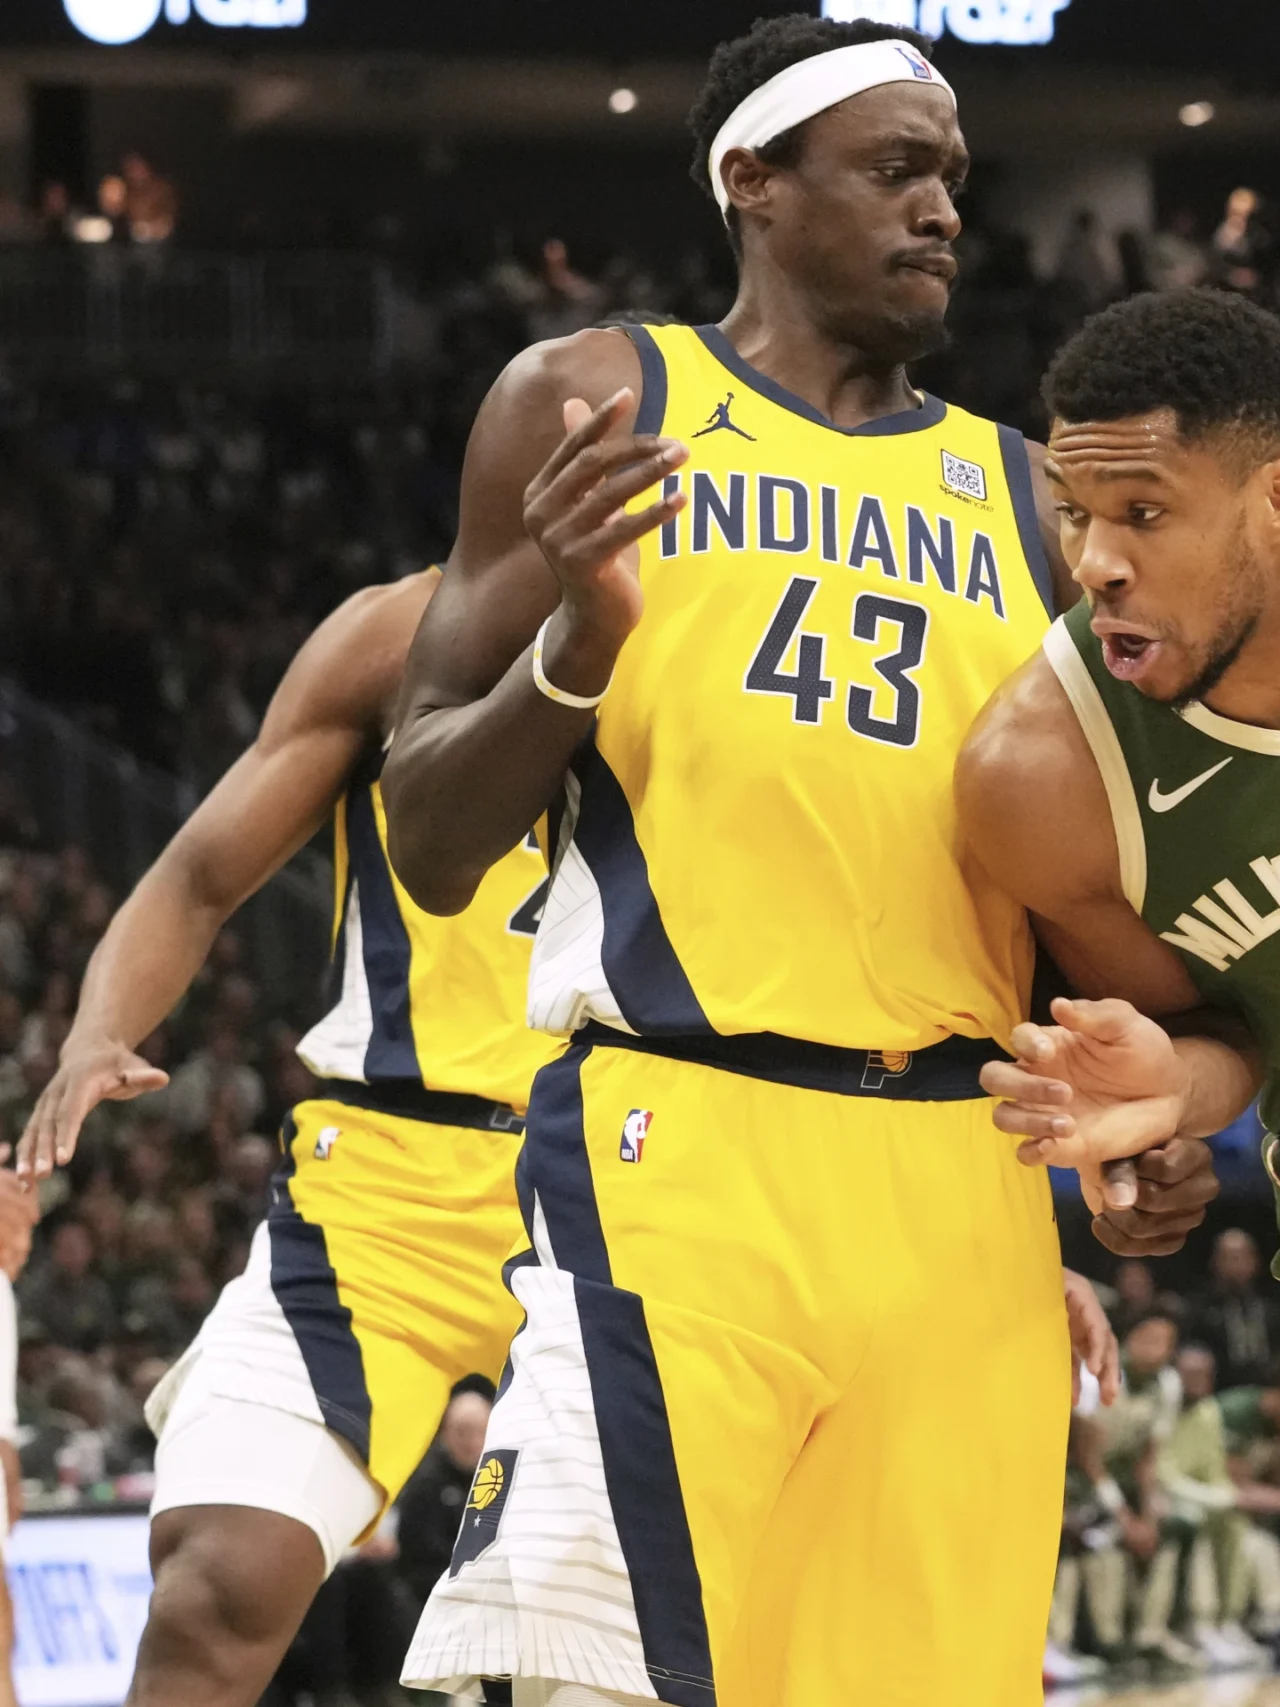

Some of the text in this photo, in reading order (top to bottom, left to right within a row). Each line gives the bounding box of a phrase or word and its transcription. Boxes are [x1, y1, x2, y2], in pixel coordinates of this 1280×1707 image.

[659, 470, 1007, 622] INDIANA
[939, 484, 994, 512] spokenote
[742, 576, 928, 749] 43
